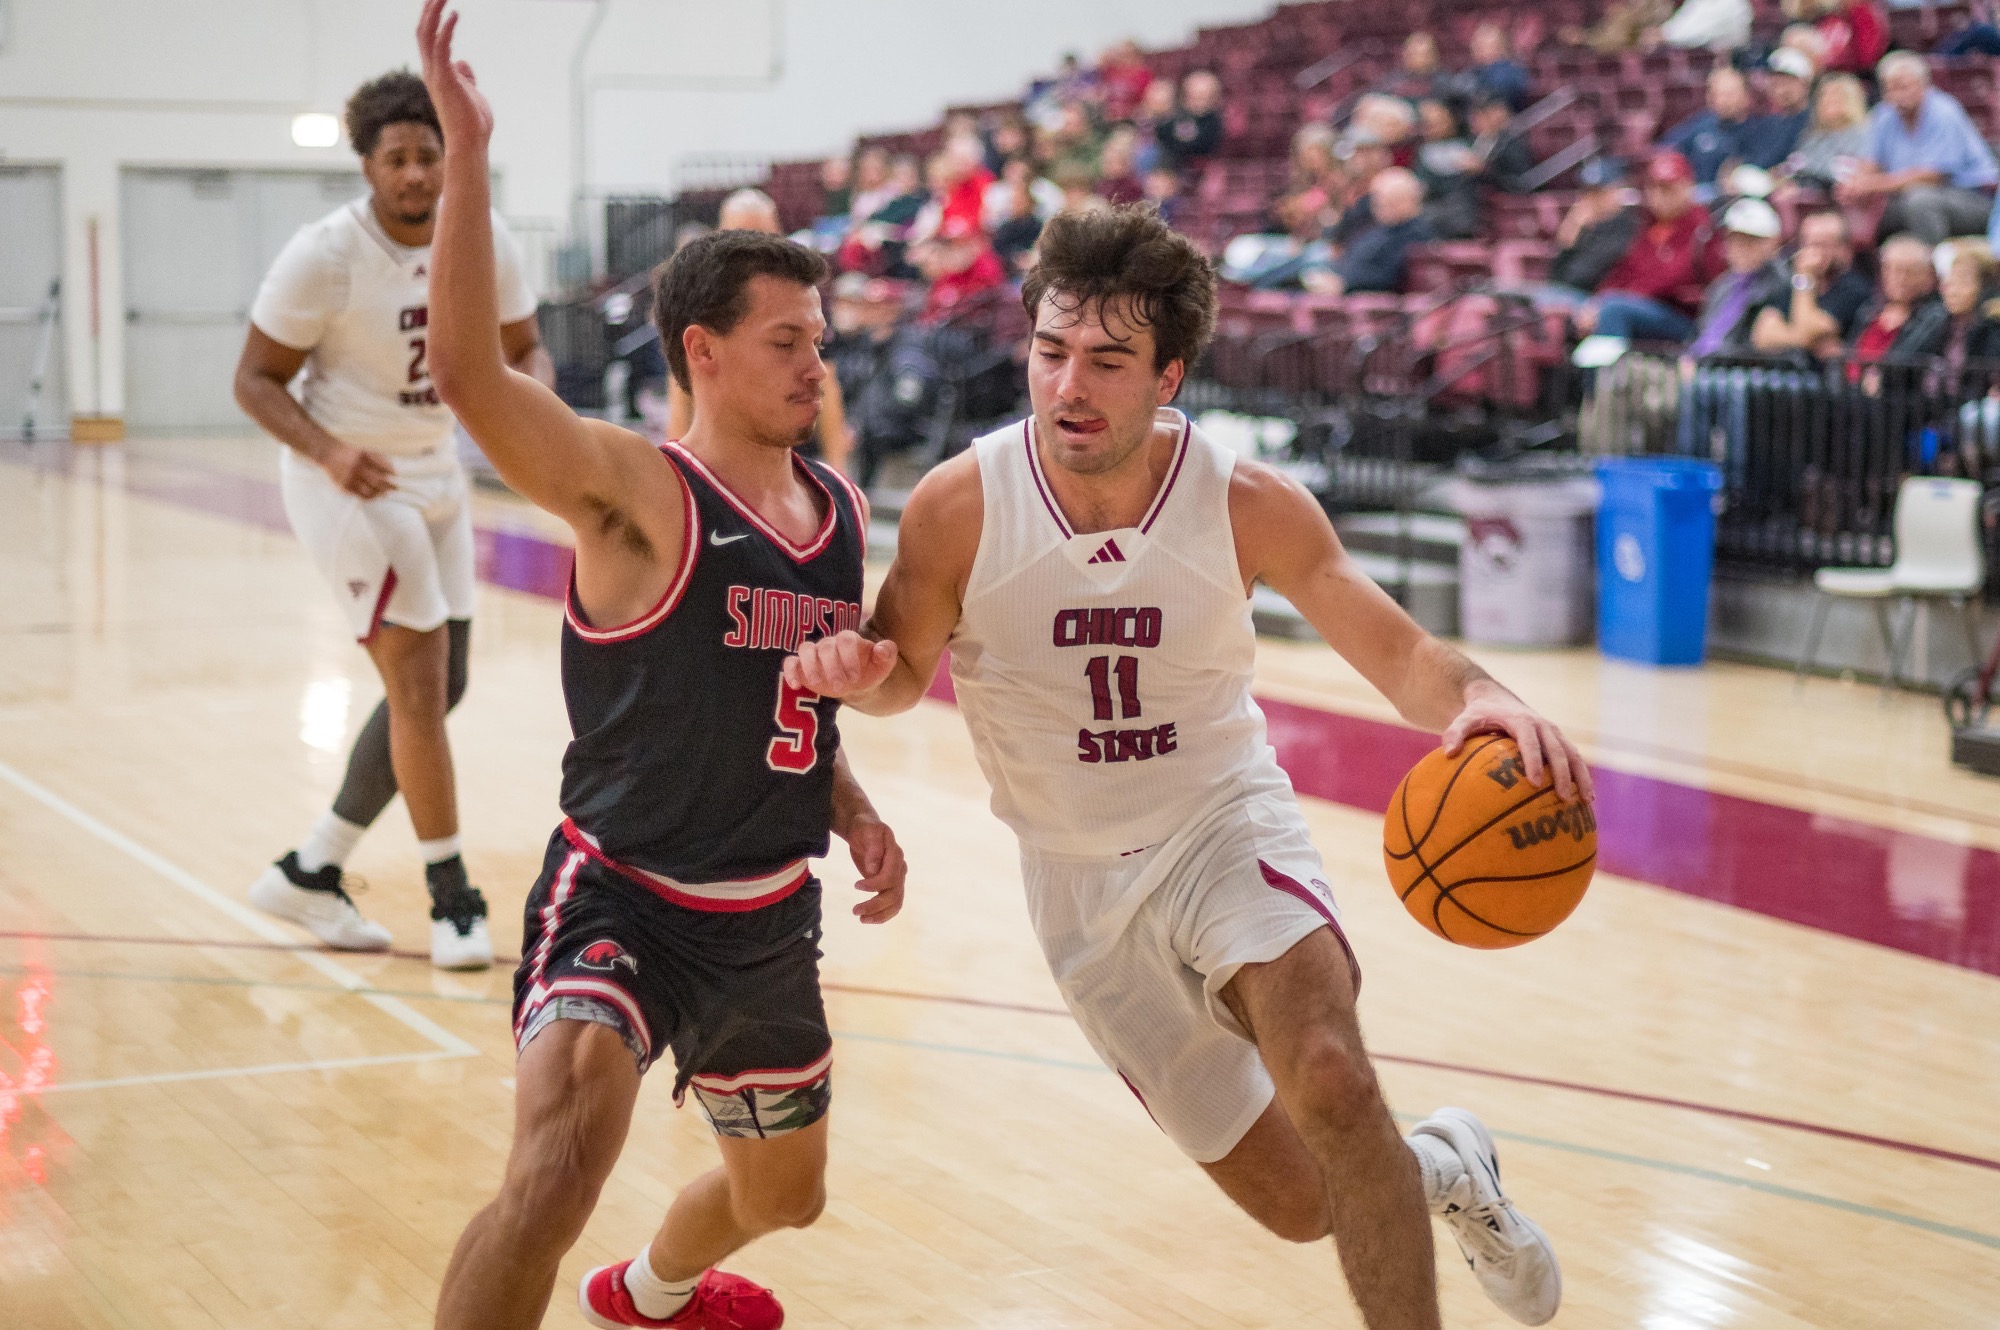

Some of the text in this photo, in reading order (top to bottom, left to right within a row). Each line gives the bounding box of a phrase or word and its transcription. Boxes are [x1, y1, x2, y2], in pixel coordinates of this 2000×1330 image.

[408, 339, 430, 382] 2
[1053, 606, 1163, 648] CHICO
[1084, 655, 1142, 721] 11
[768, 671, 819, 774] 5
[1078, 721, 1178, 763] STATE
